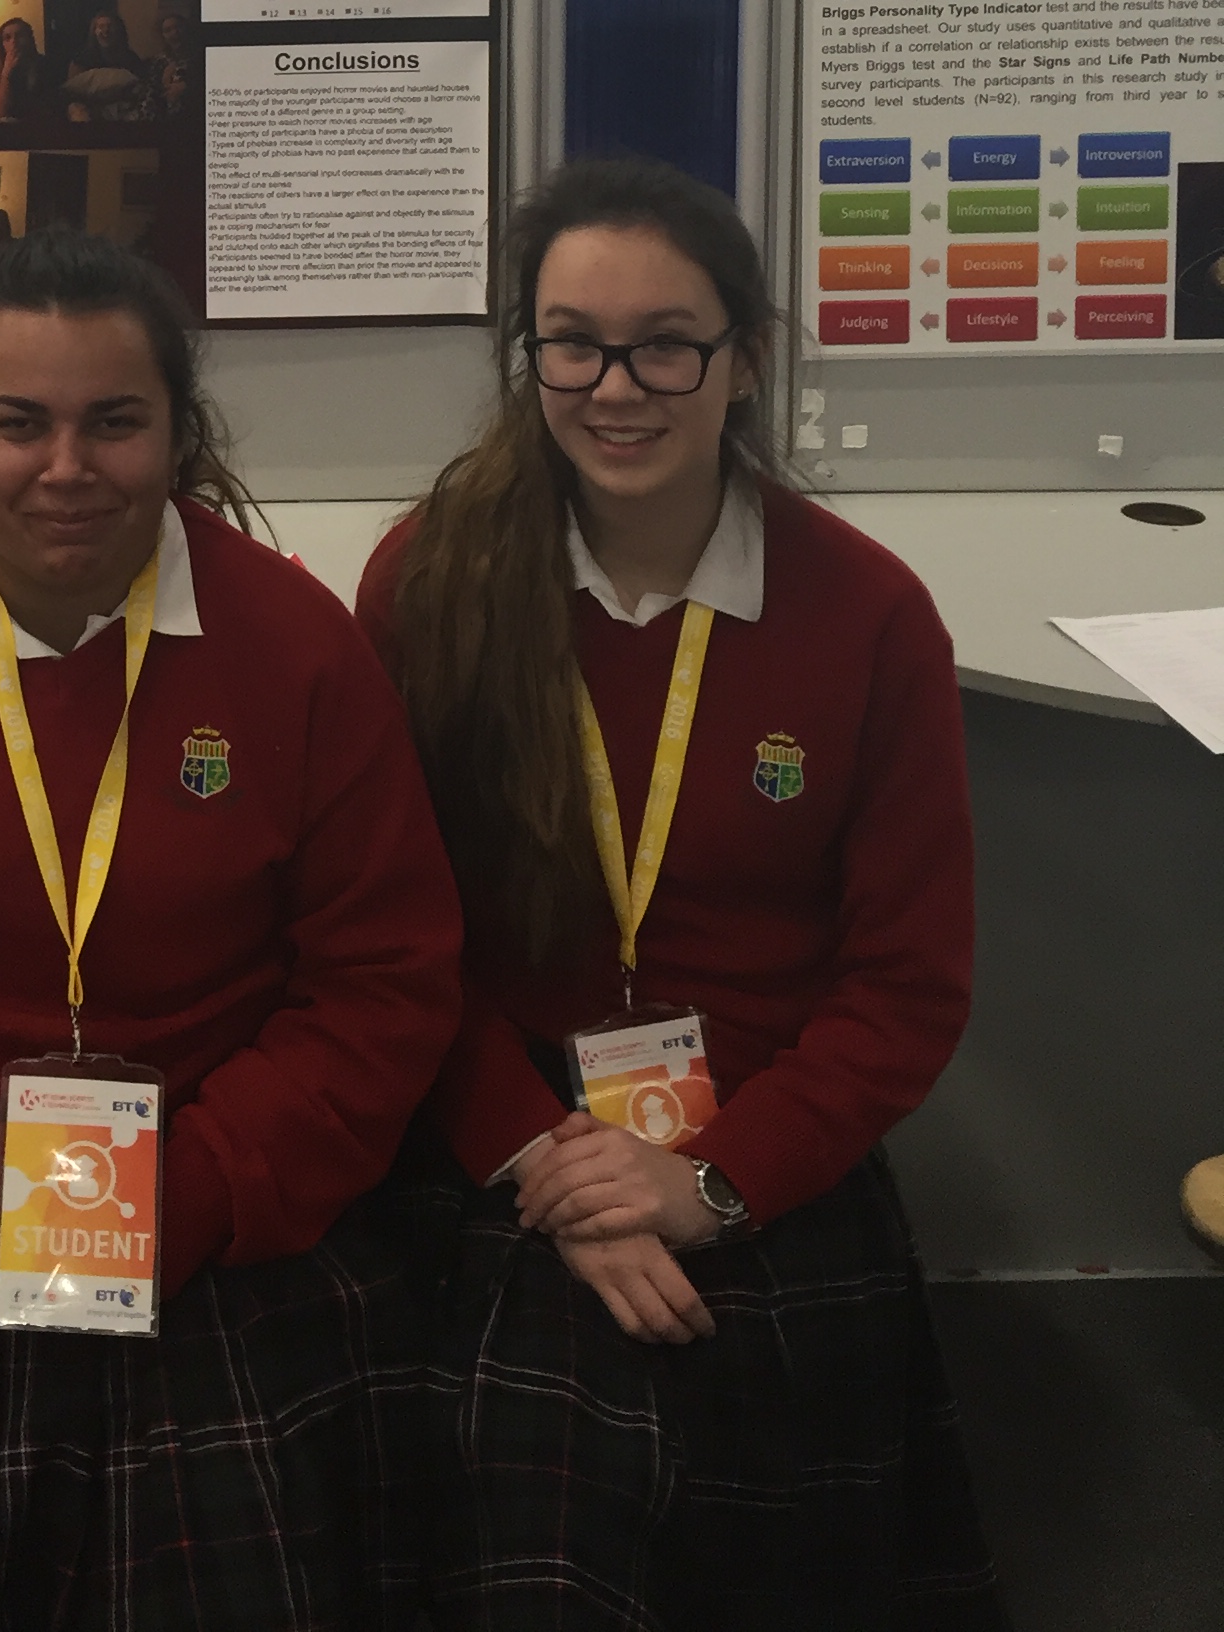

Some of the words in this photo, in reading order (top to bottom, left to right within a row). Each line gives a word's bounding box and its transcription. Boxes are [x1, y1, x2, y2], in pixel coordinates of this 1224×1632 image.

[274, 50, 419, 71] Conclusions
[826, 154, 904, 167] Extraversion
[973, 151, 1017, 165] Energy
[1085, 149, 1163, 160] Introversion
[841, 206, 889, 220] Sensing
[956, 203, 1032, 216] Information
[1096, 201, 1151, 213] Intuition
[837, 260, 892, 275] Thinking
[963, 257, 1024, 271] Decisions
[1099, 255, 1145, 270] Feeling
[840, 315, 888, 330] Judging
[966, 312, 1018, 326] Lifestyle
[1088, 311, 1154, 324] Perceiving
[662, 1037, 681, 1049] BT
[112, 1101, 134, 1112] BT
[14, 1227, 151, 1262] STUDENT
[95, 1289, 118, 1302] BT
